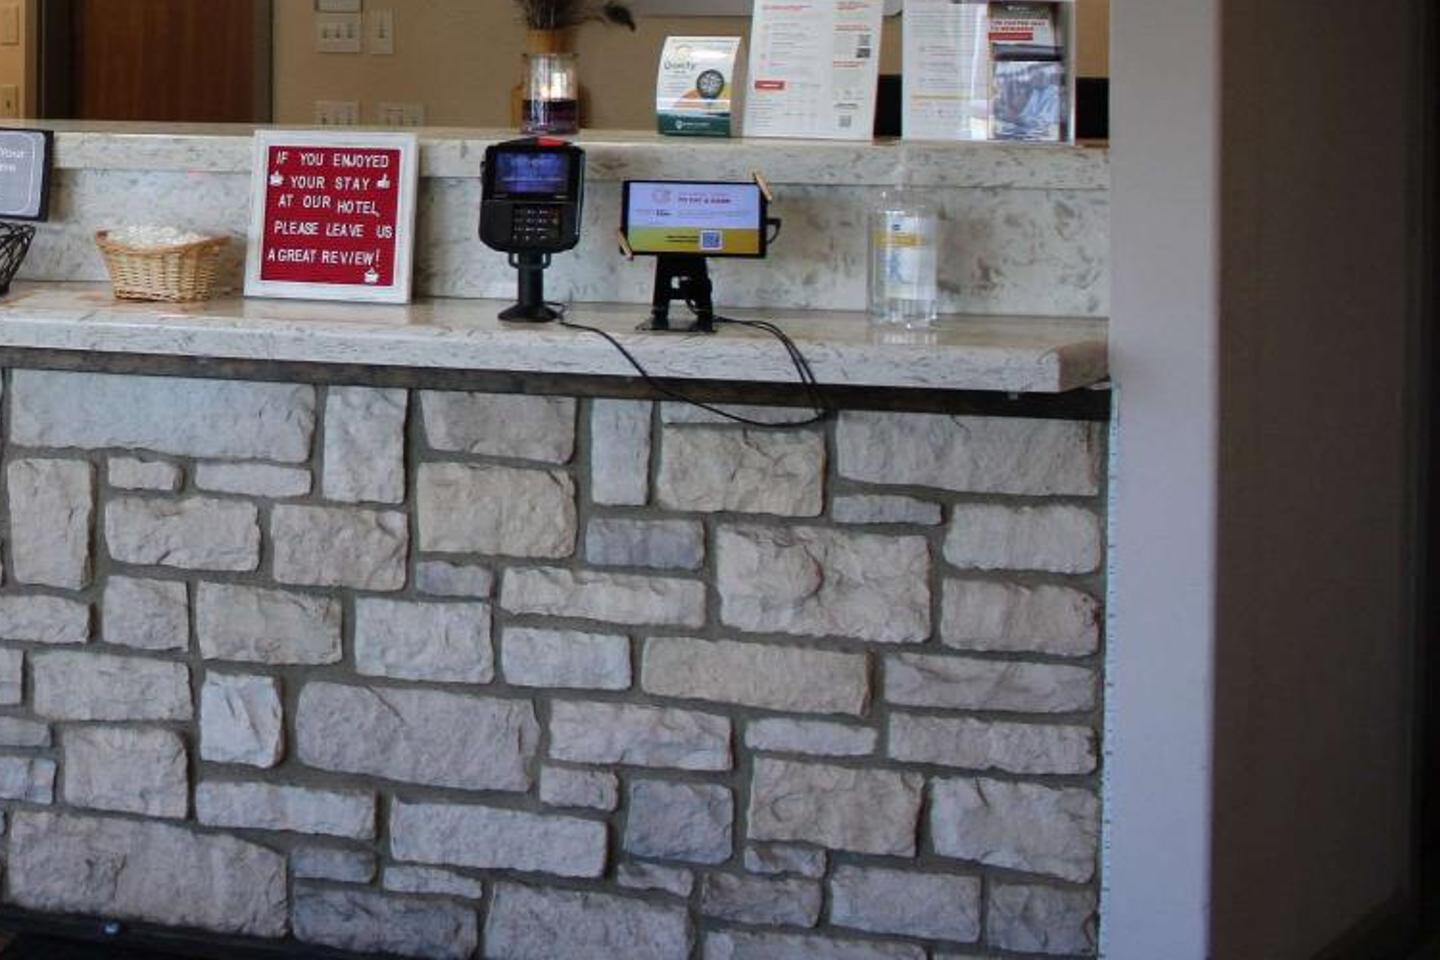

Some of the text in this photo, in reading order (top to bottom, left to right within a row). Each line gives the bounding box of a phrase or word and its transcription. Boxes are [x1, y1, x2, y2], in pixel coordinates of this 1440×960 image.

[0, 147, 26, 159] Your
[276, 151, 389, 168] IF YOU ENJOYED
[290, 175, 370, 190] YOUR STAY
[278, 194, 294, 208] AT
[303, 195, 331, 208] OUR
[274, 220, 393, 239] PLEASE LEAVE US
[267, 247, 276, 262] A
[277, 248, 317, 263] GREAT
